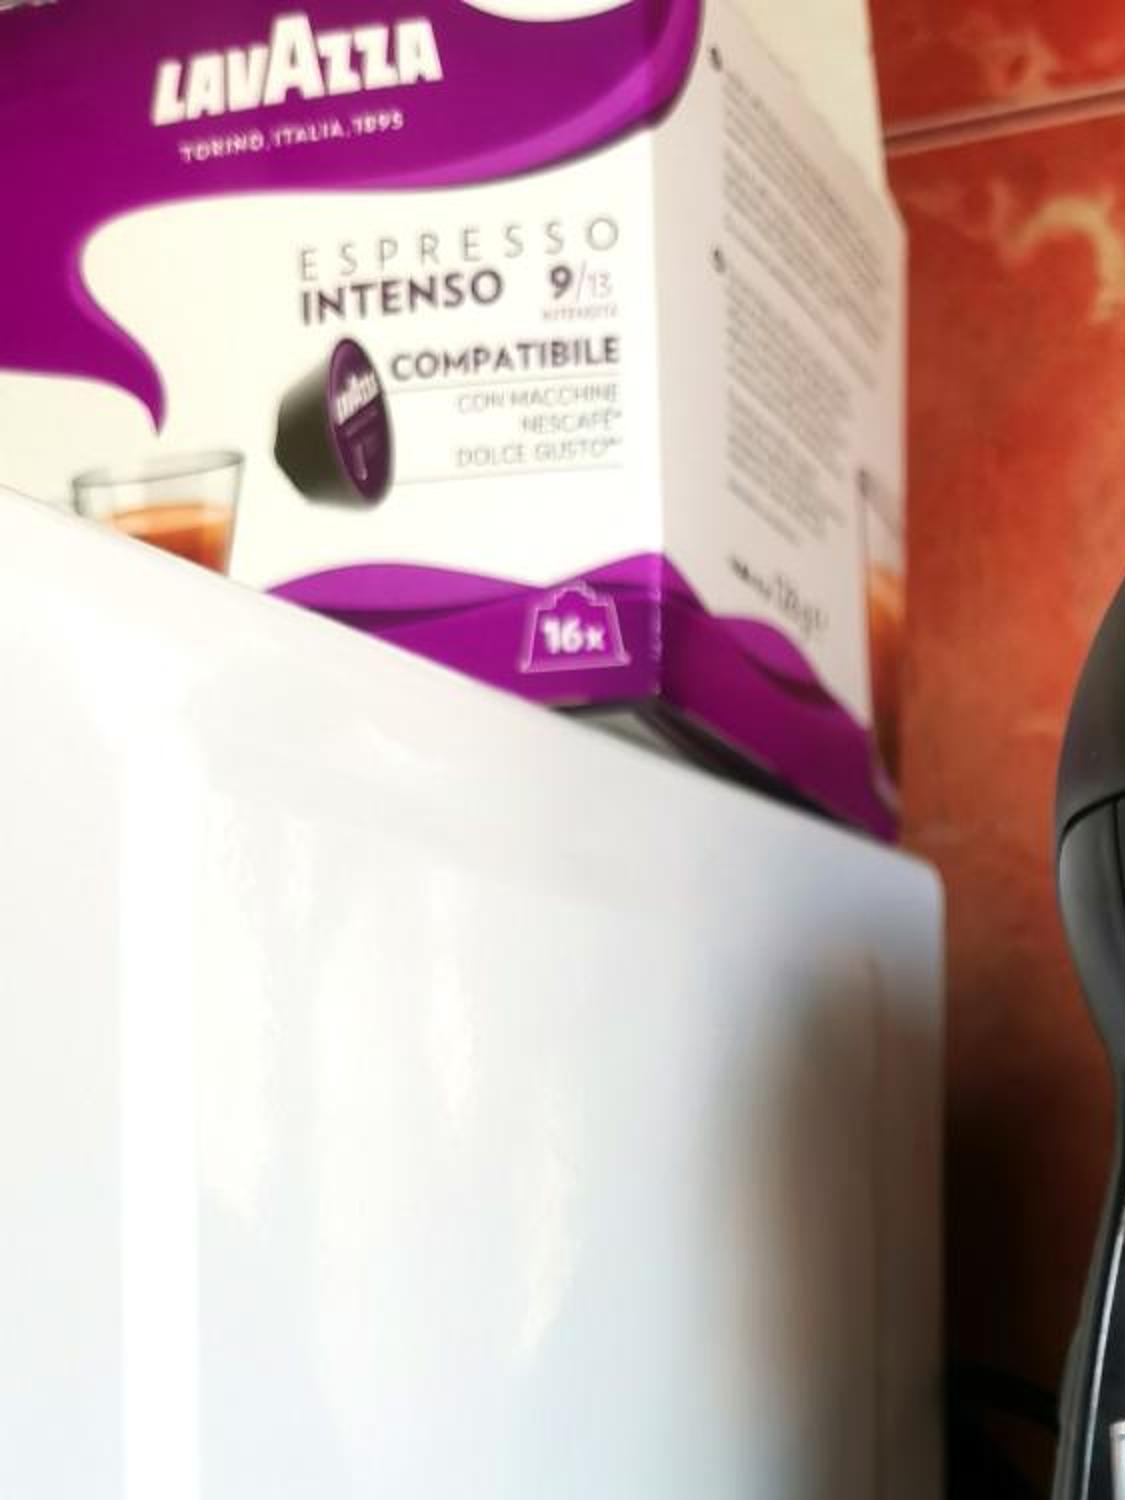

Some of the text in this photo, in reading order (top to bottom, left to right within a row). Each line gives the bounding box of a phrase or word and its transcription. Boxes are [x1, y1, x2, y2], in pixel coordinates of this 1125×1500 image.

[152, 10, 444, 127] LAVAZZA
[299, 216, 620, 282] ESPRESSO
[301, 268, 505, 325] INTENSO
[391, 337, 621, 382] COMPATIBILE
[457, 391, 505, 414] CON
[457, 443, 529, 467] DOLCE
[541, 616, 606, 655] 16x
